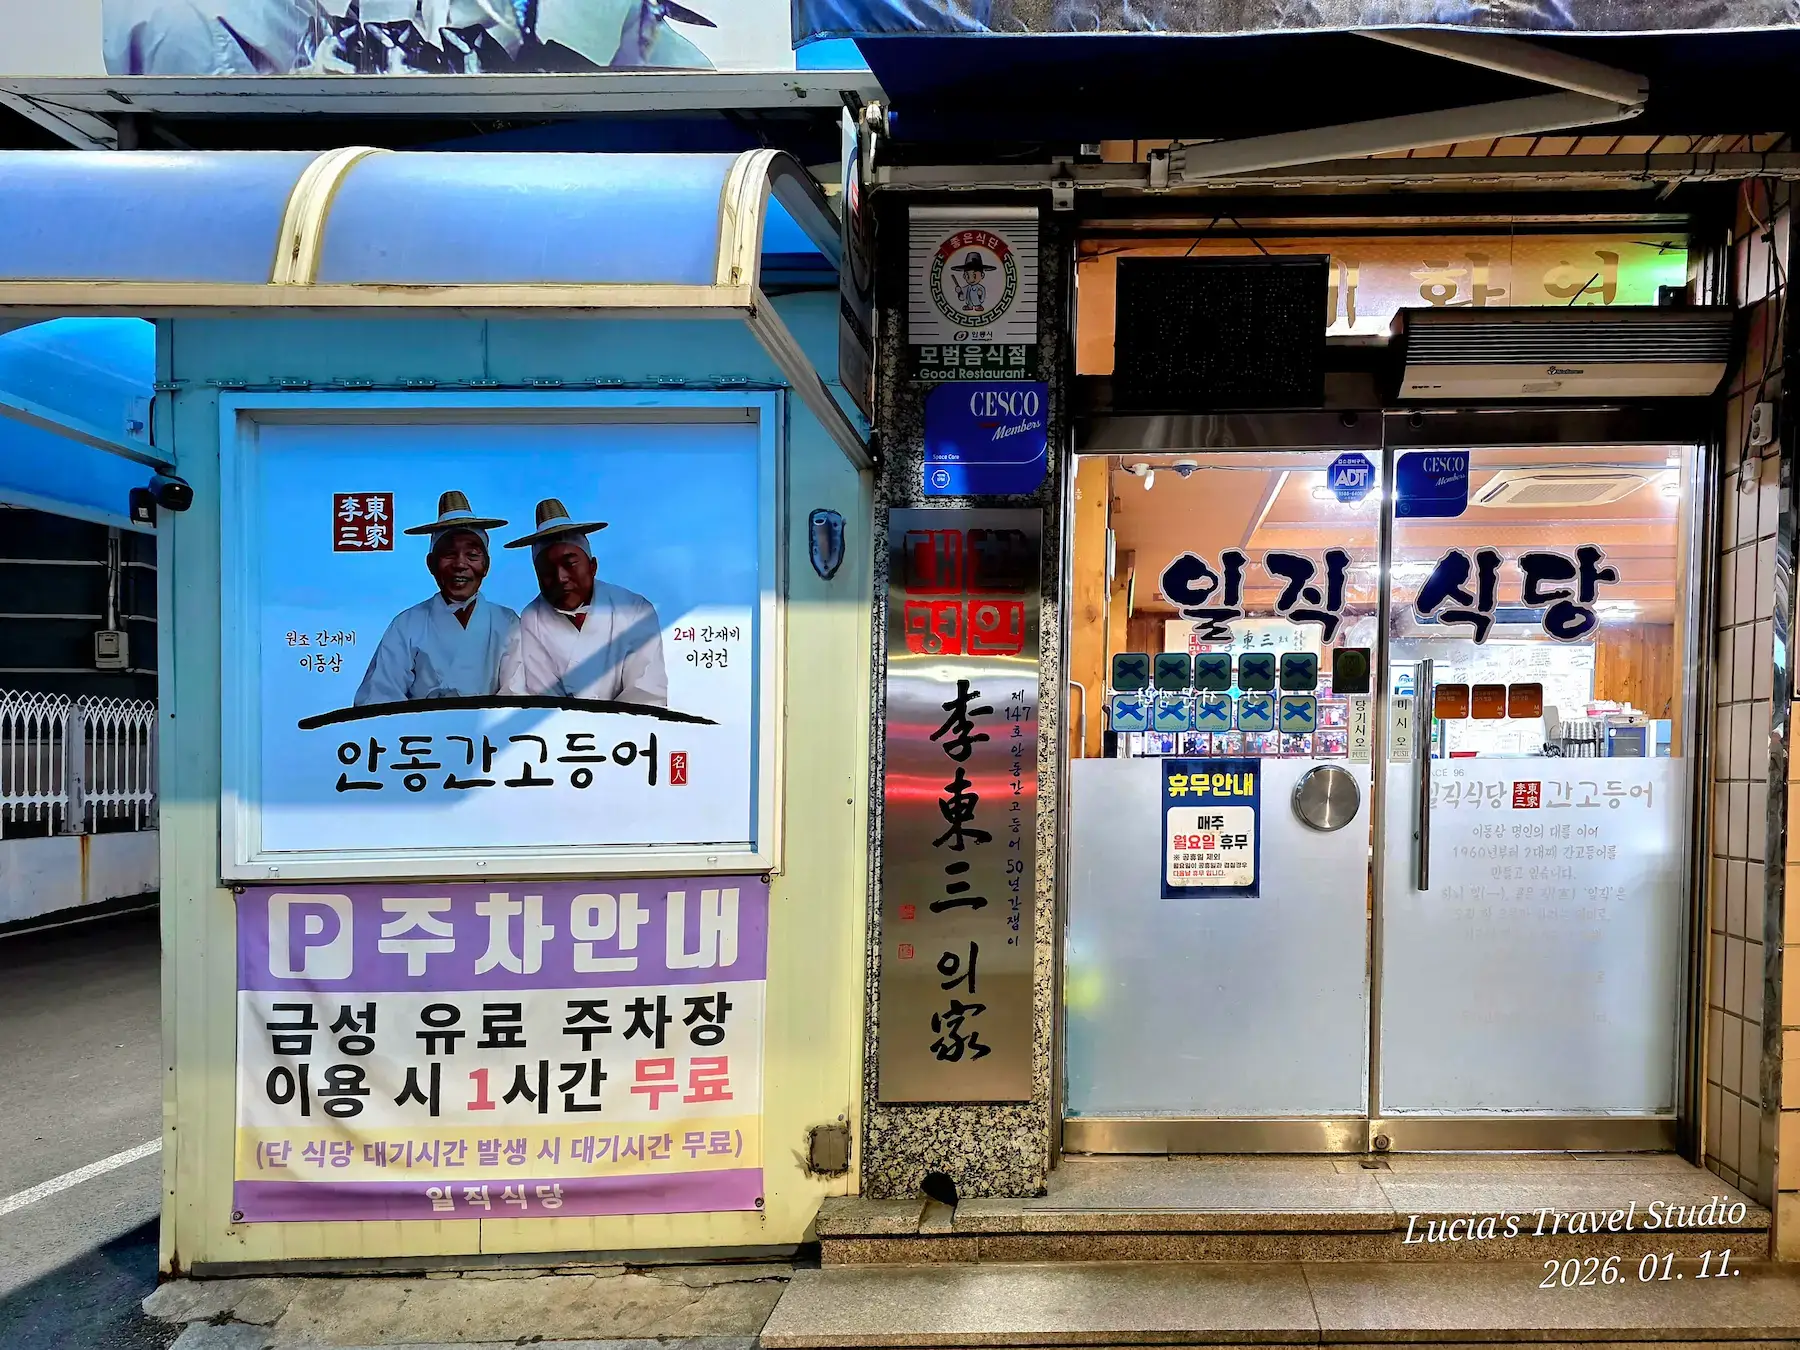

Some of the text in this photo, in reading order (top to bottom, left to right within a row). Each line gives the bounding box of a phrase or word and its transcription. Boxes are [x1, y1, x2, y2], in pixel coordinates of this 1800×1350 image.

[919, 345, 1027, 366] 모범음식점
[919, 368, 1025, 379] Good Restaurant
[970, 391, 1039, 417] CESCO
[992, 417, 1041, 441] Members
[1423, 457, 1464, 472] CESCO
[1334, 469, 1367, 486] ADT
[1159, 543, 1621, 646] 일직 식당
[285, 629, 356, 647] 원조 간재비
[674, 625, 740, 643] 2대 간재비
[906, 602, 1023, 654] 명인
[300, 652, 343, 673] 이동삼
[686, 648, 728, 669] 이정건
[1355, 700, 1366, 748] 당기시오
[1396, 699, 1407, 746] 미시오
[335, 733, 657, 792] 안동간고등어
[671, 754, 687, 785] 名人
[1453, 769, 1465, 777] 96
[1168, 773, 1254, 797] 휴무안내
[1546, 781, 1653, 809] 간고등어
[1197, 815, 1224, 830] 매주
[1472, 824, 1599, 840] 이동삼 명인의 대를 이어
[1173, 834, 1248, 850] 월요일 휴무
[1453, 846, 1519, 860] 1960년부터
[1563, 845, 1618, 860] 간고등어를
[378, 888, 739, 977] 주차안내
[266, 992, 733, 1056] 금성 유료 주차장
[266, 1056, 734, 1118] 이용 시 1시간 무료
[255, 1129, 744, 1169] (단 식당 대기시간 발생 시 대기시간 무료)
[425, 1183, 565, 1212] 일직식당
